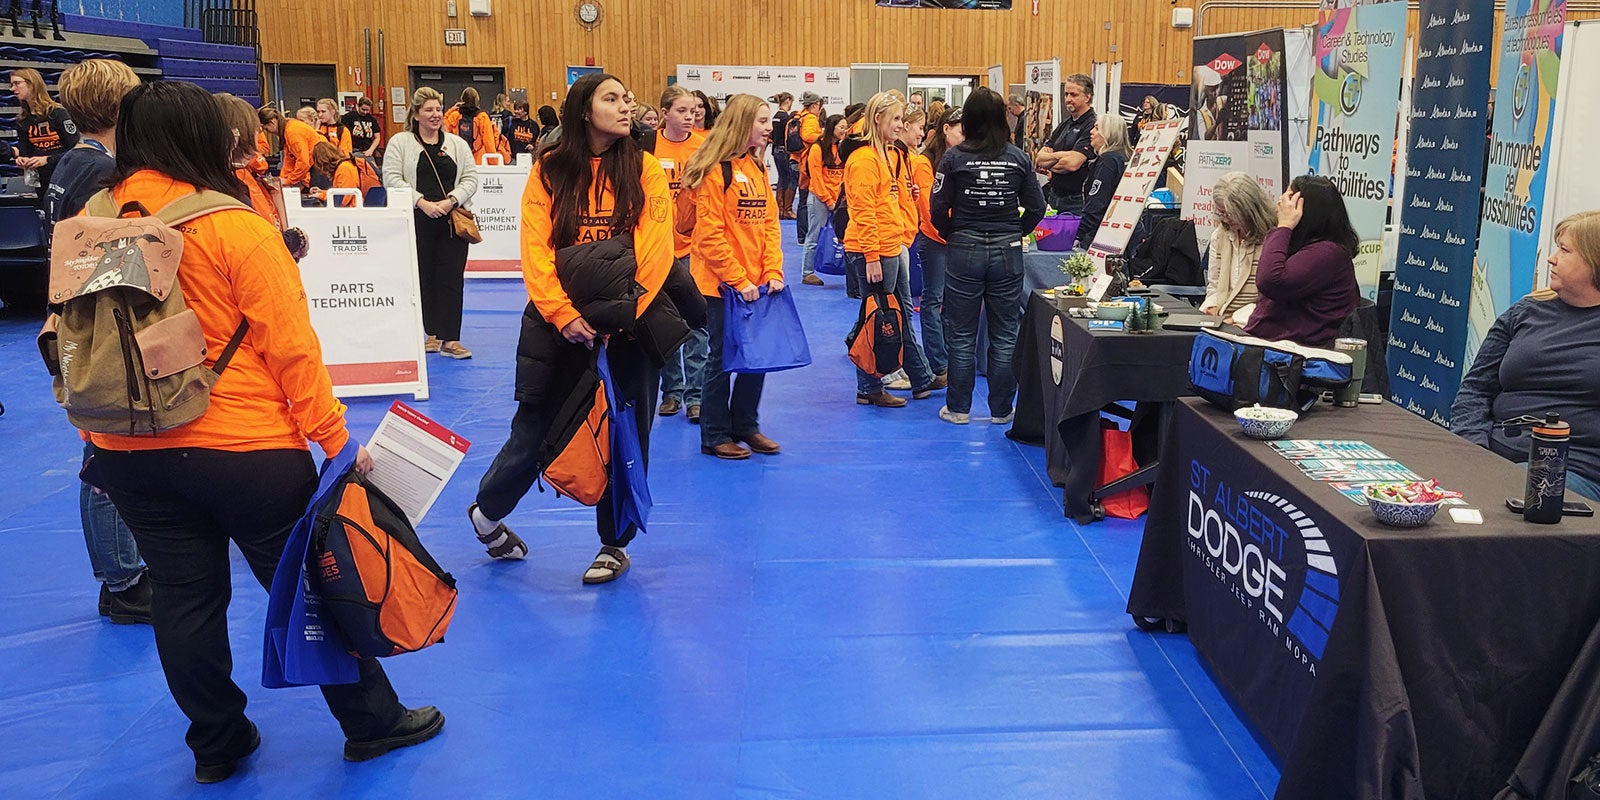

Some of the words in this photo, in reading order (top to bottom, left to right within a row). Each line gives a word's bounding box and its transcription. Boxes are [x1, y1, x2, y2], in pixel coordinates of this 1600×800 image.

[448, 32, 462, 42] EXIT
[1322, 34, 1344, 48] Career
[1346, 32, 1351, 46] &
[1354, 30, 1395, 47] Technology
[1342, 50, 1368, 63] Studies
[1315, 126, 1380, 160] Pathways
[1490, 132, 1503, 165] Un
[1504, 136, 1542, 171] monde
[1340, 154, 1349, 170] to
[483, 178, 503, 186] JILL
[1505, 168, 1514, 192] de
[1197, 185, 1212, 196] Are
[476, 215, 516, 223] QUIPMENT
[332, 225, 367, 238] JILL
[331, 283, 374, 293] PARTS
[311, 297, 395, 309] TECHNICIAN
[1190, 459, 1211, 495] ST
[1215, 480, 1289, 561] ALBERT
[1188, 490, 1286, 624] DODGE
[1187, 537, 1226, 584] CHRYSLER
[1231, 582, 1252, 608] JEEP
[1259, 609, 1279, 638] RAM
[1286, 636, 1316, 677] MOPA
